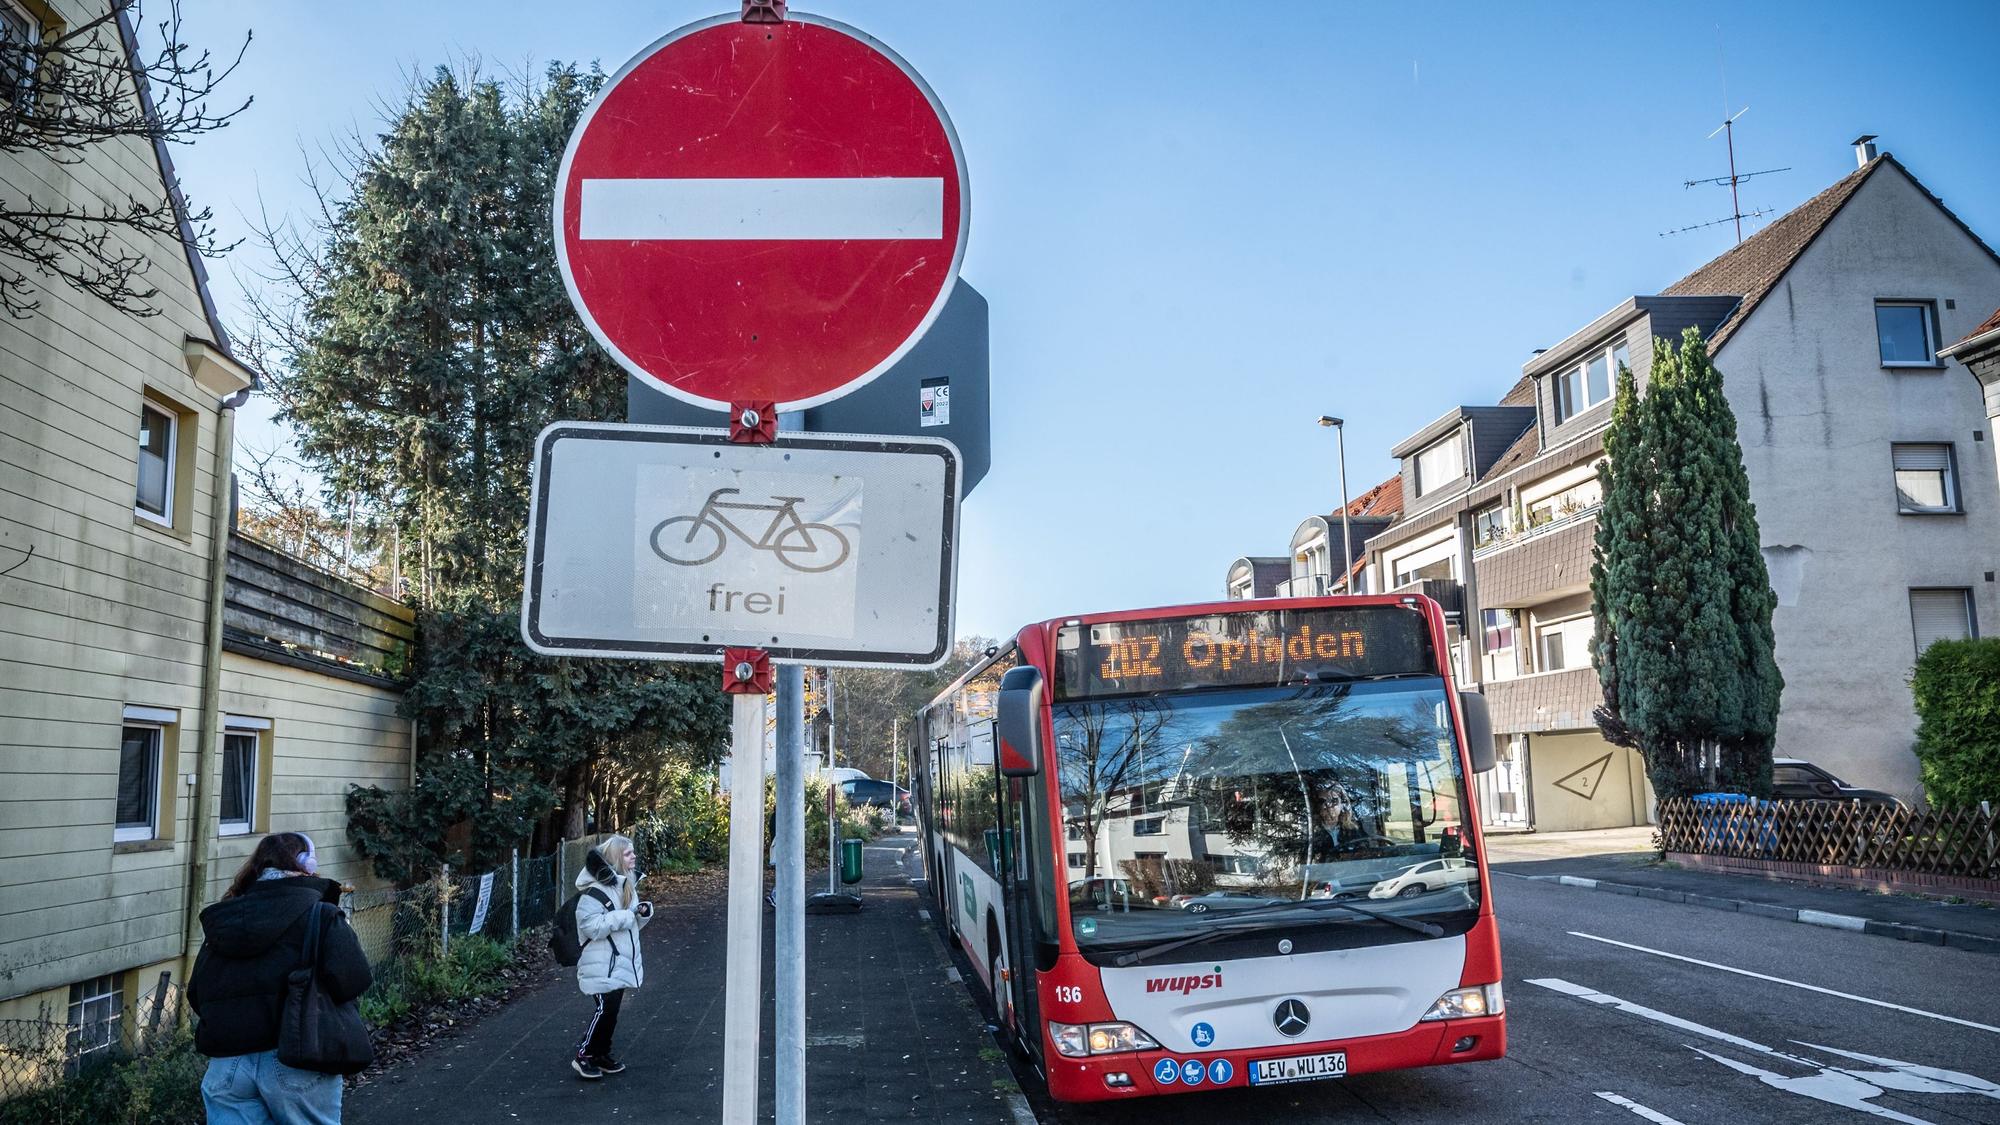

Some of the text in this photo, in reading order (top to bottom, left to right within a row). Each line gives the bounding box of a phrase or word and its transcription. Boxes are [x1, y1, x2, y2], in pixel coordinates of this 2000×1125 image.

[936, 387, 949, 397] CE
[706, 583, 786, 615] frei
[1099, 624, 1364, 679] 202 Opladen
[1582, 777, 1589, 787] 2
[1146, 965, 1223, 995] wupsi
[1056, 985, 1082, 1003] 136
[1259, 1061, 1286, 1080] LEV
[1296, 1057, 1316, 1075] WU
[1318, 1055, 1345, 1073] 136
